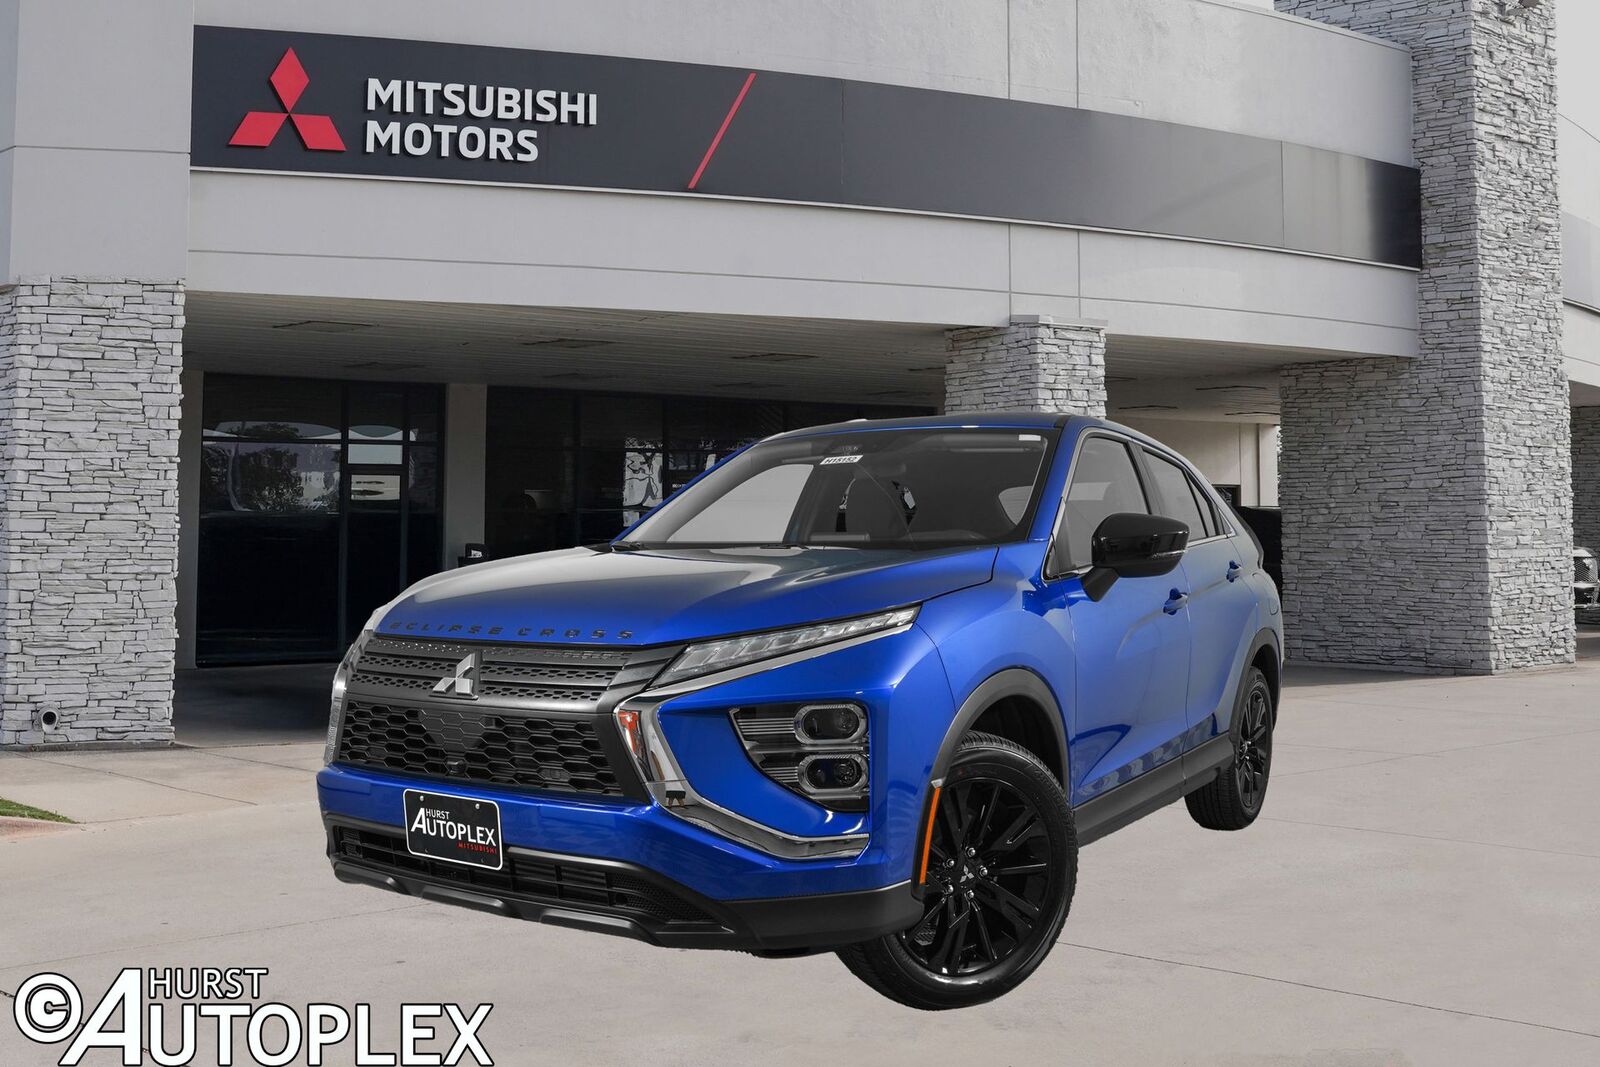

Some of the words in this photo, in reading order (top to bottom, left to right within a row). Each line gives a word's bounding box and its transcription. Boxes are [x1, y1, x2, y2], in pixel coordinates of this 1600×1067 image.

[366, 77, 598, 127] MITSUBISHI
[365, 120, 540, 163] MOTORS
[389, 621, 504, 635] ECLIPSE
[517, 626, 633, 639] CROSS
[410, 807, 497, 847] AUTOPLEX
[425, 808, 450, 820] HURST
[456, 842, 498, 855] MITSUBISHI
